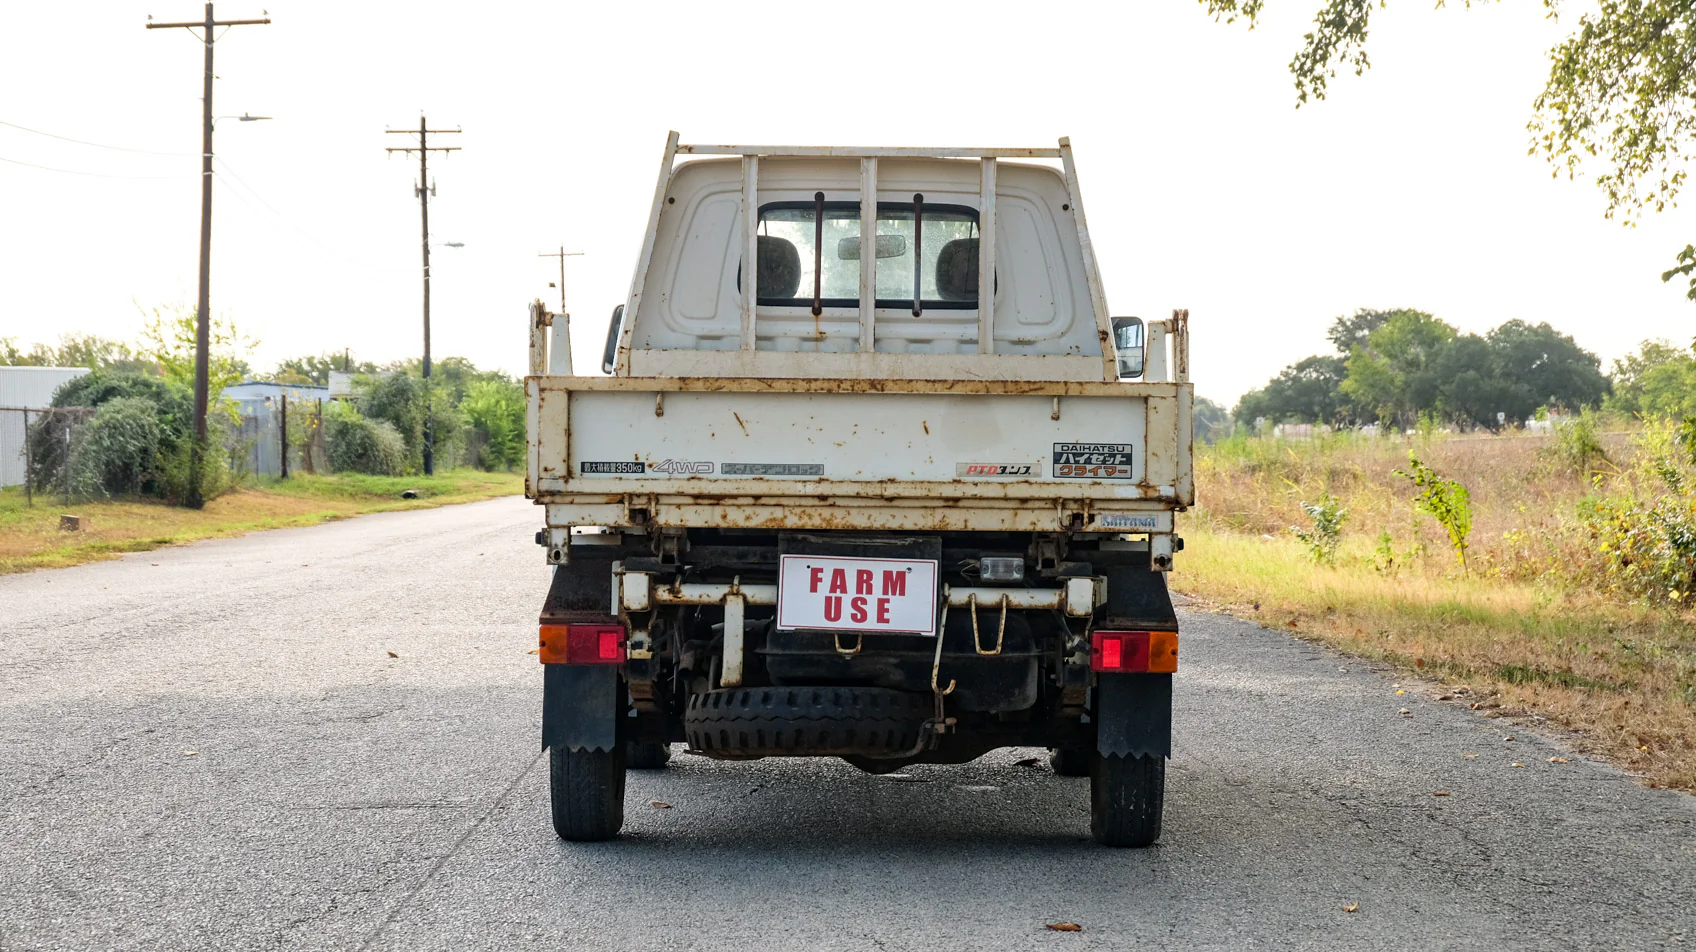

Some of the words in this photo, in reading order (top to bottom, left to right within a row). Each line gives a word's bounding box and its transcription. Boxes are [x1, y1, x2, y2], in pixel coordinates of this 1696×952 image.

[1061, 445, 1125, 453] DAIHATSU
[1059, 453, 1127, 464] ハイゼット
[652, 459, 715, 474] 4WD
[1059, 465, 1128, 476] クライマー
[809, 567, 907, 597] FARM
[823, 596, 891, 624] USE
